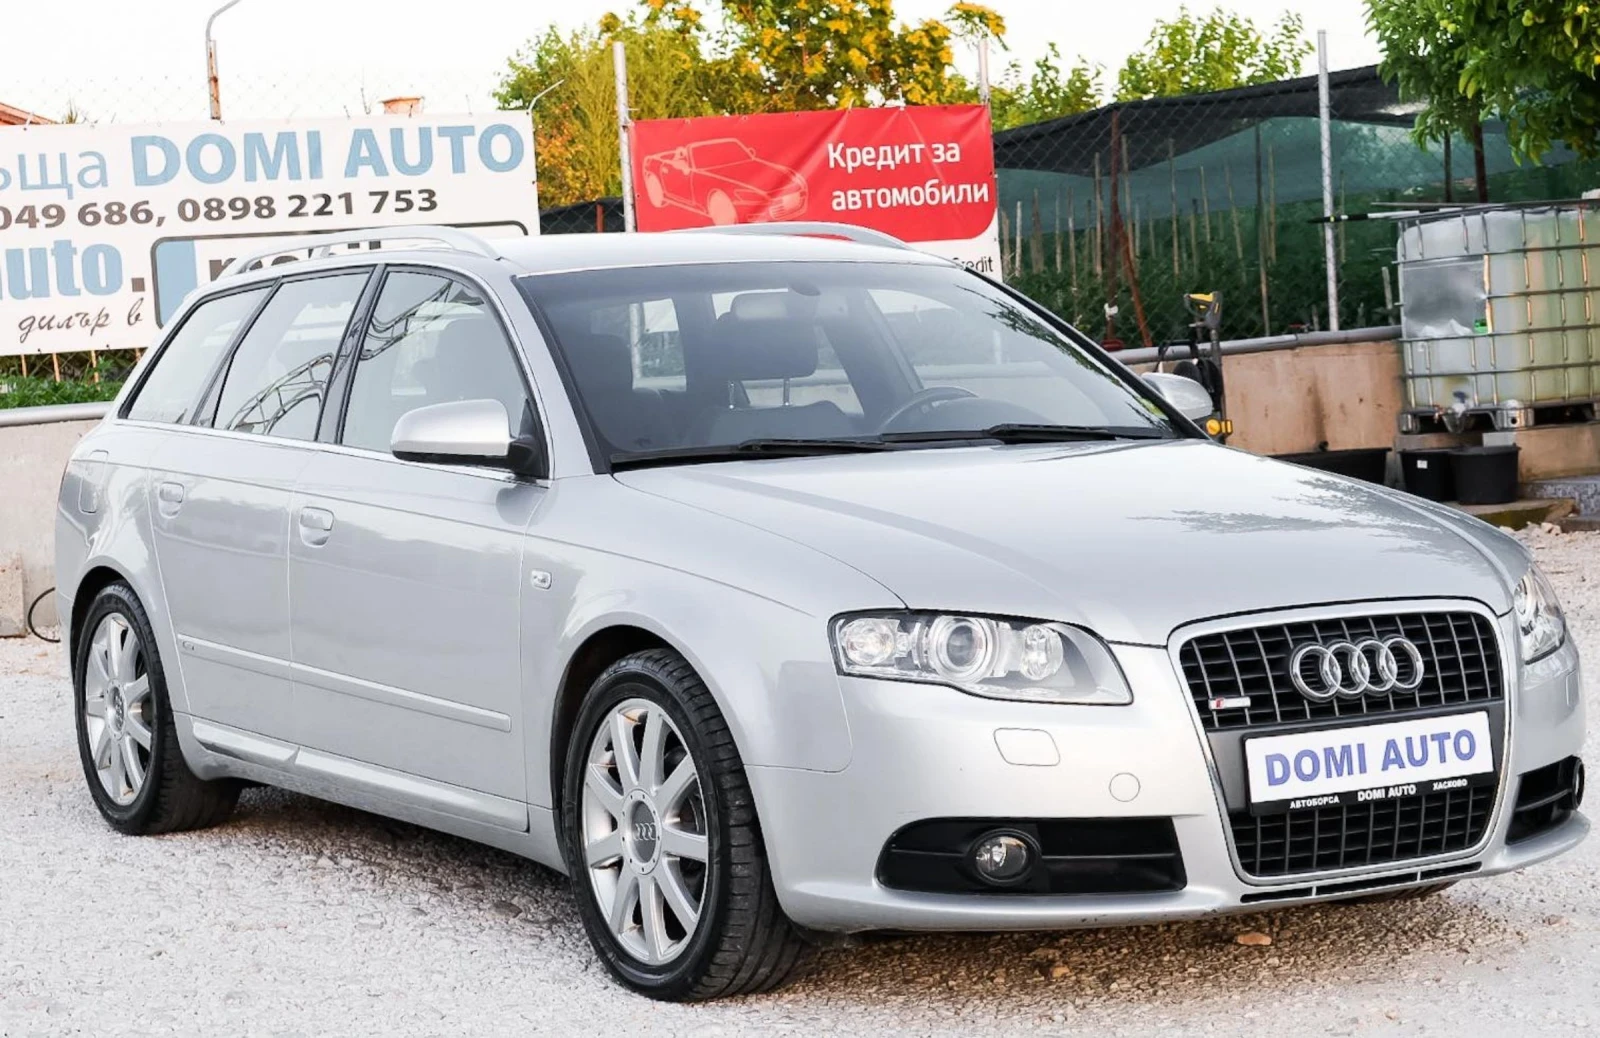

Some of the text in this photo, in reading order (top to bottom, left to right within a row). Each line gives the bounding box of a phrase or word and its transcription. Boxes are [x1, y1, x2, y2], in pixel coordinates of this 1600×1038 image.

[131, 130, 321, 187] DOMI
[344, 124, 525, 179] AUTO
[828, 141, 961, 173] Кредит за
[77, 200, 166, 227] 686,
[177, 196, 276, 222] 0898
[288, 192, 354, 217] 221
[368, 189, 438, 214] 753
[831, 179, 989, 211] автомобили
[18, 306, 110, 343] дилър
[1265, 728, 1476, 788] DOMI AUTO
[1290, 795, 1340, 809] АВТОБОРСА
[1357, 788, 1385, 801] DOMI
[1388, 784, 1417, 797] AUTO
